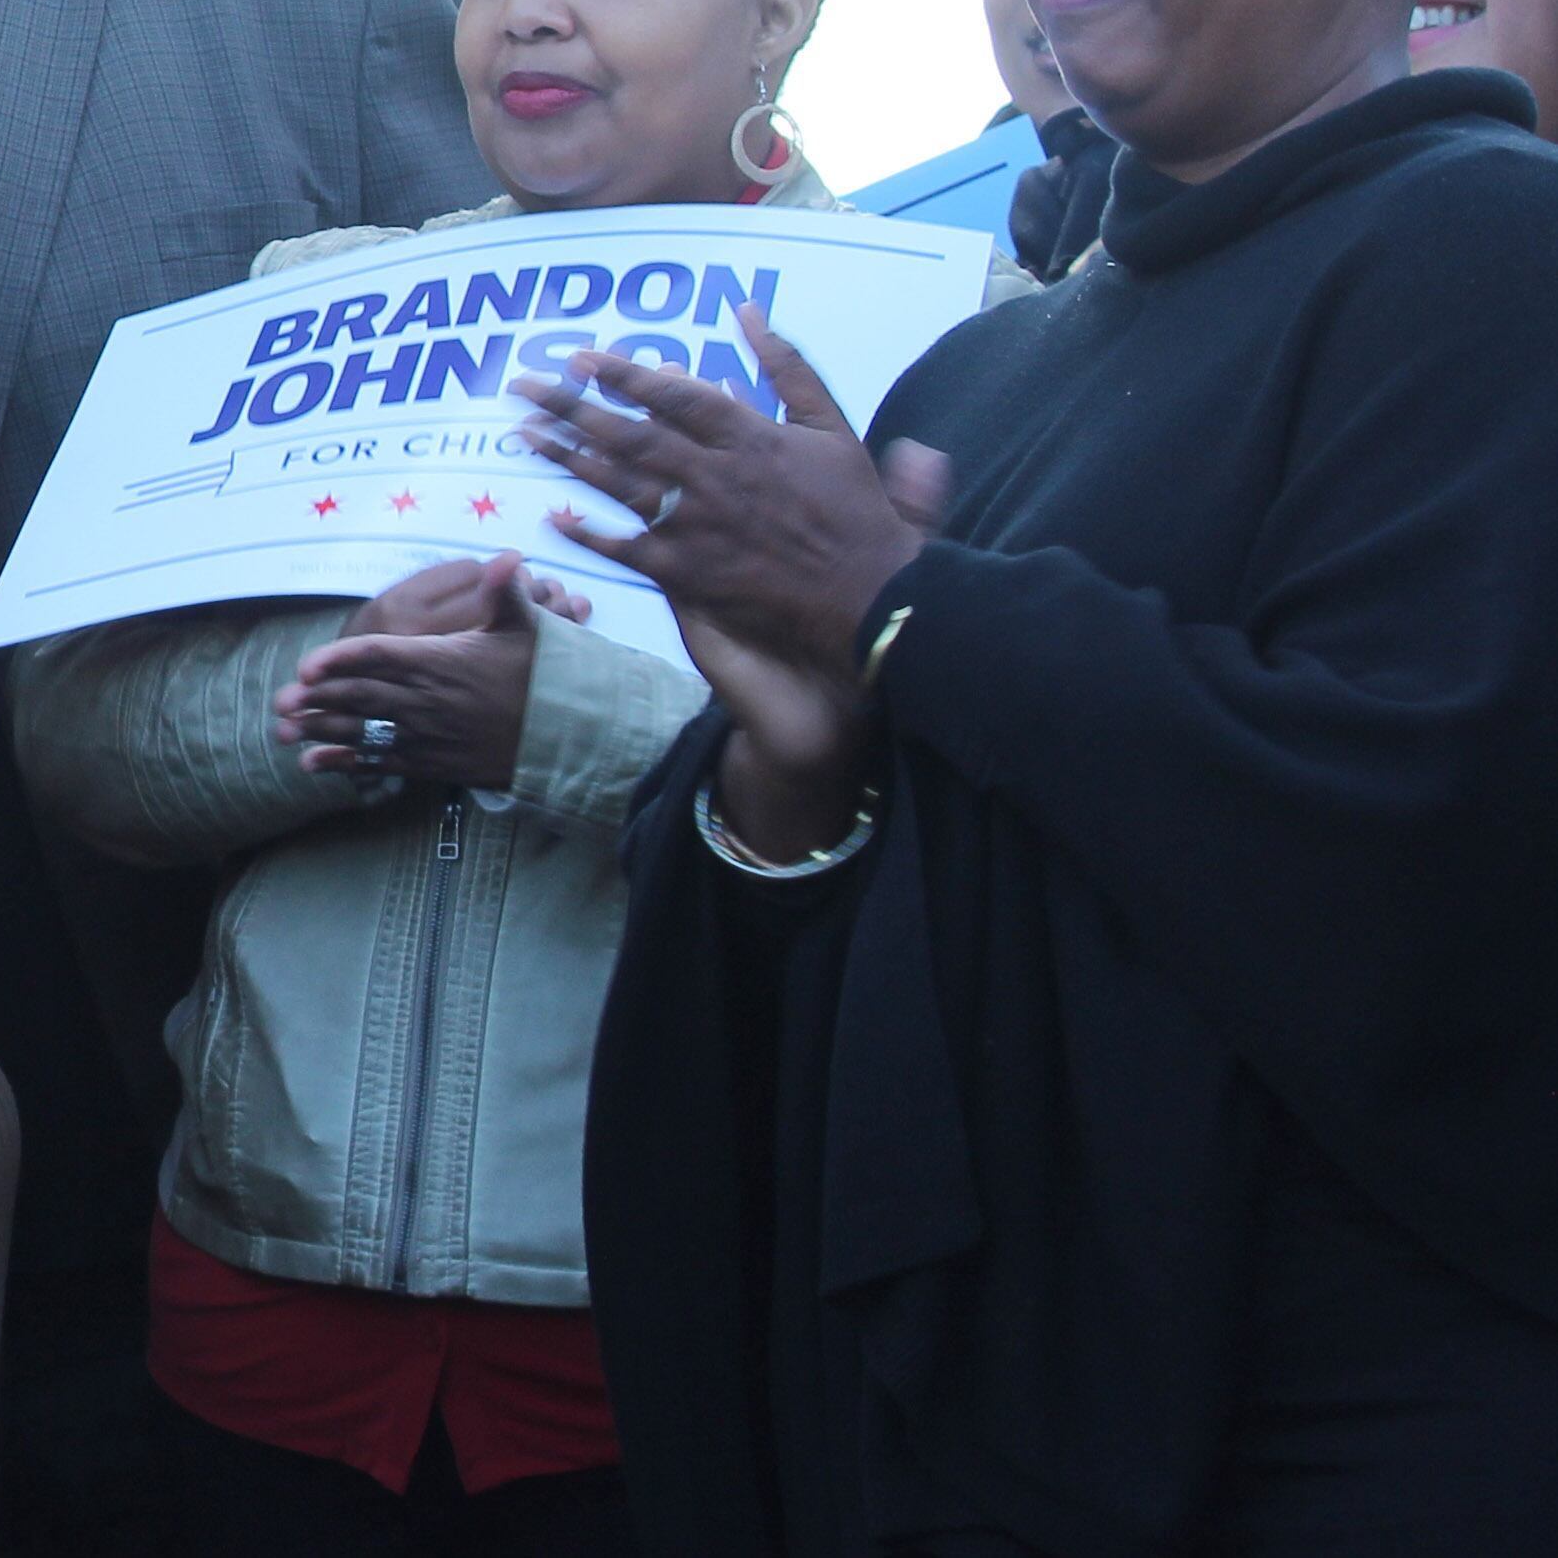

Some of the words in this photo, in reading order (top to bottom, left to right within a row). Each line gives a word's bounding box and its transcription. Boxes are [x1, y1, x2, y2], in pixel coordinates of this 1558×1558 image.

[246, 262, 781, 368] BRANDON
[281, 439, 378, 470] FOR
[402, 431, 541, 458] CHIC
